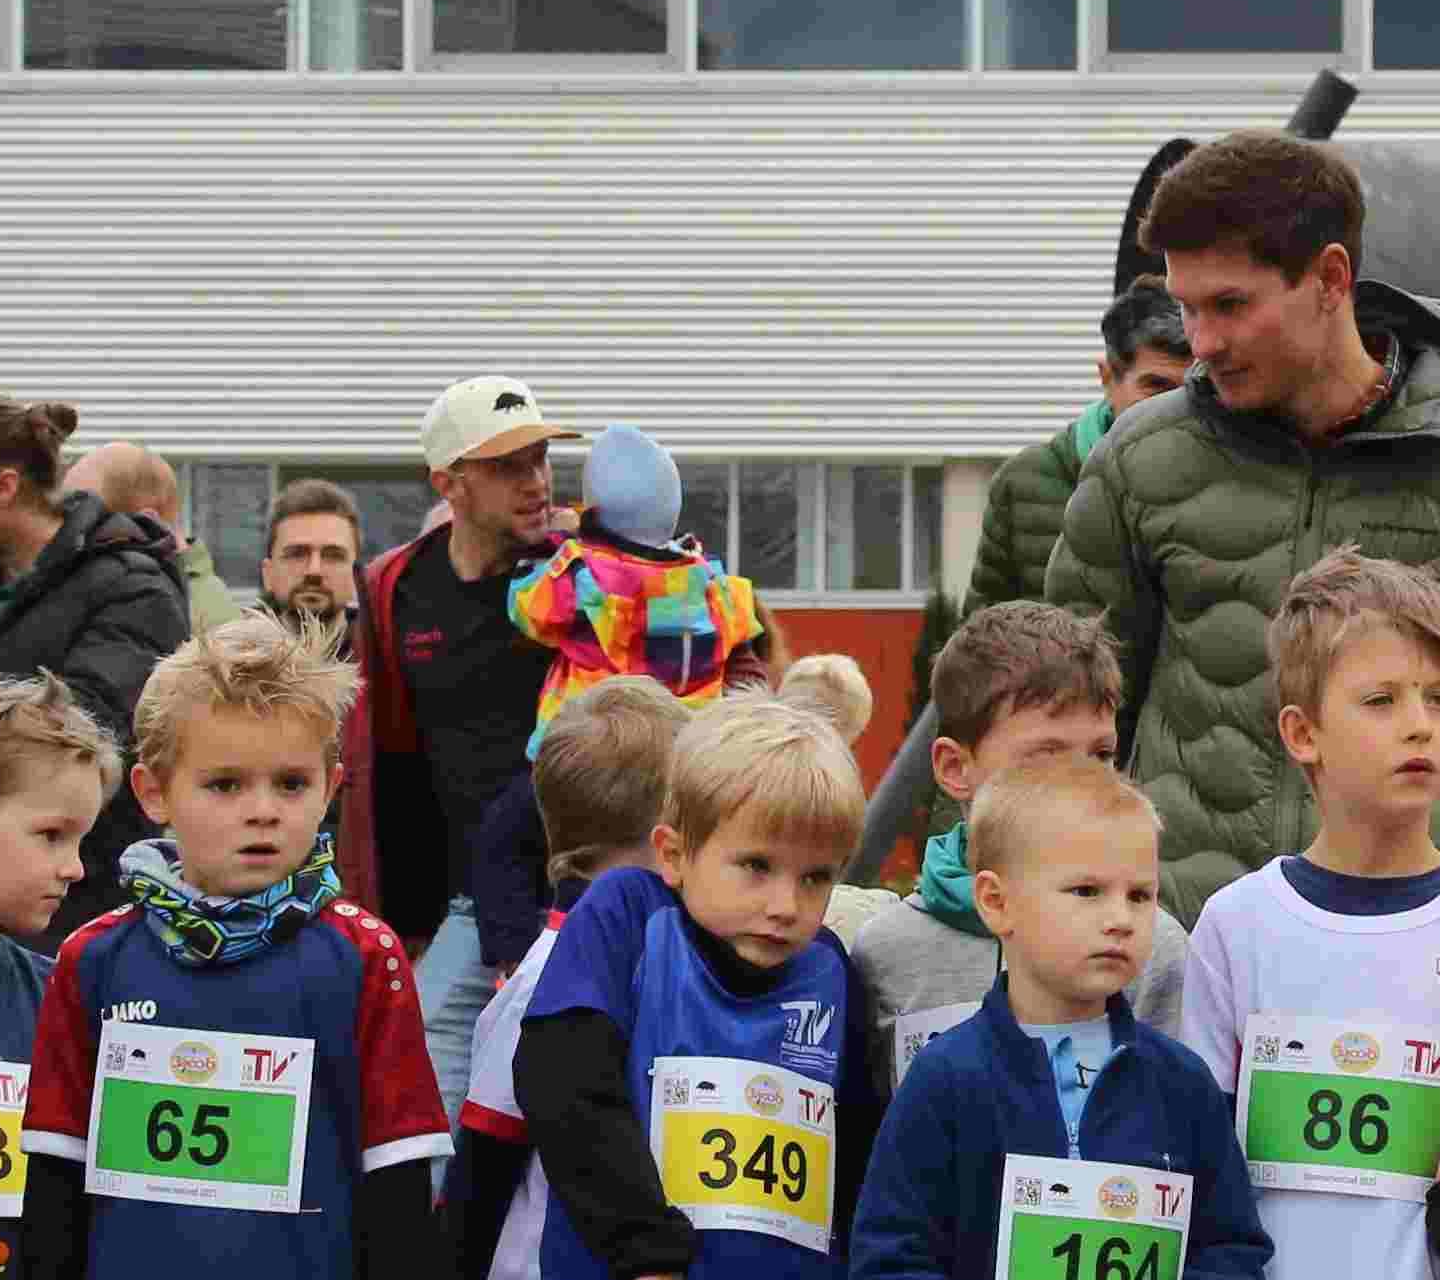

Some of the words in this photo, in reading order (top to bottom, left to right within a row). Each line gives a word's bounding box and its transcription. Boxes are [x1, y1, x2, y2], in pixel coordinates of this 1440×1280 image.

[243, 1047, 300, 1082] TV
[145, 1099, 231, 1167] 65
[1303, 1088, 1391, 1155] 86
[697, 1128, 808, 1203] 349
[1154, 1183, 1185, 1217] TV
